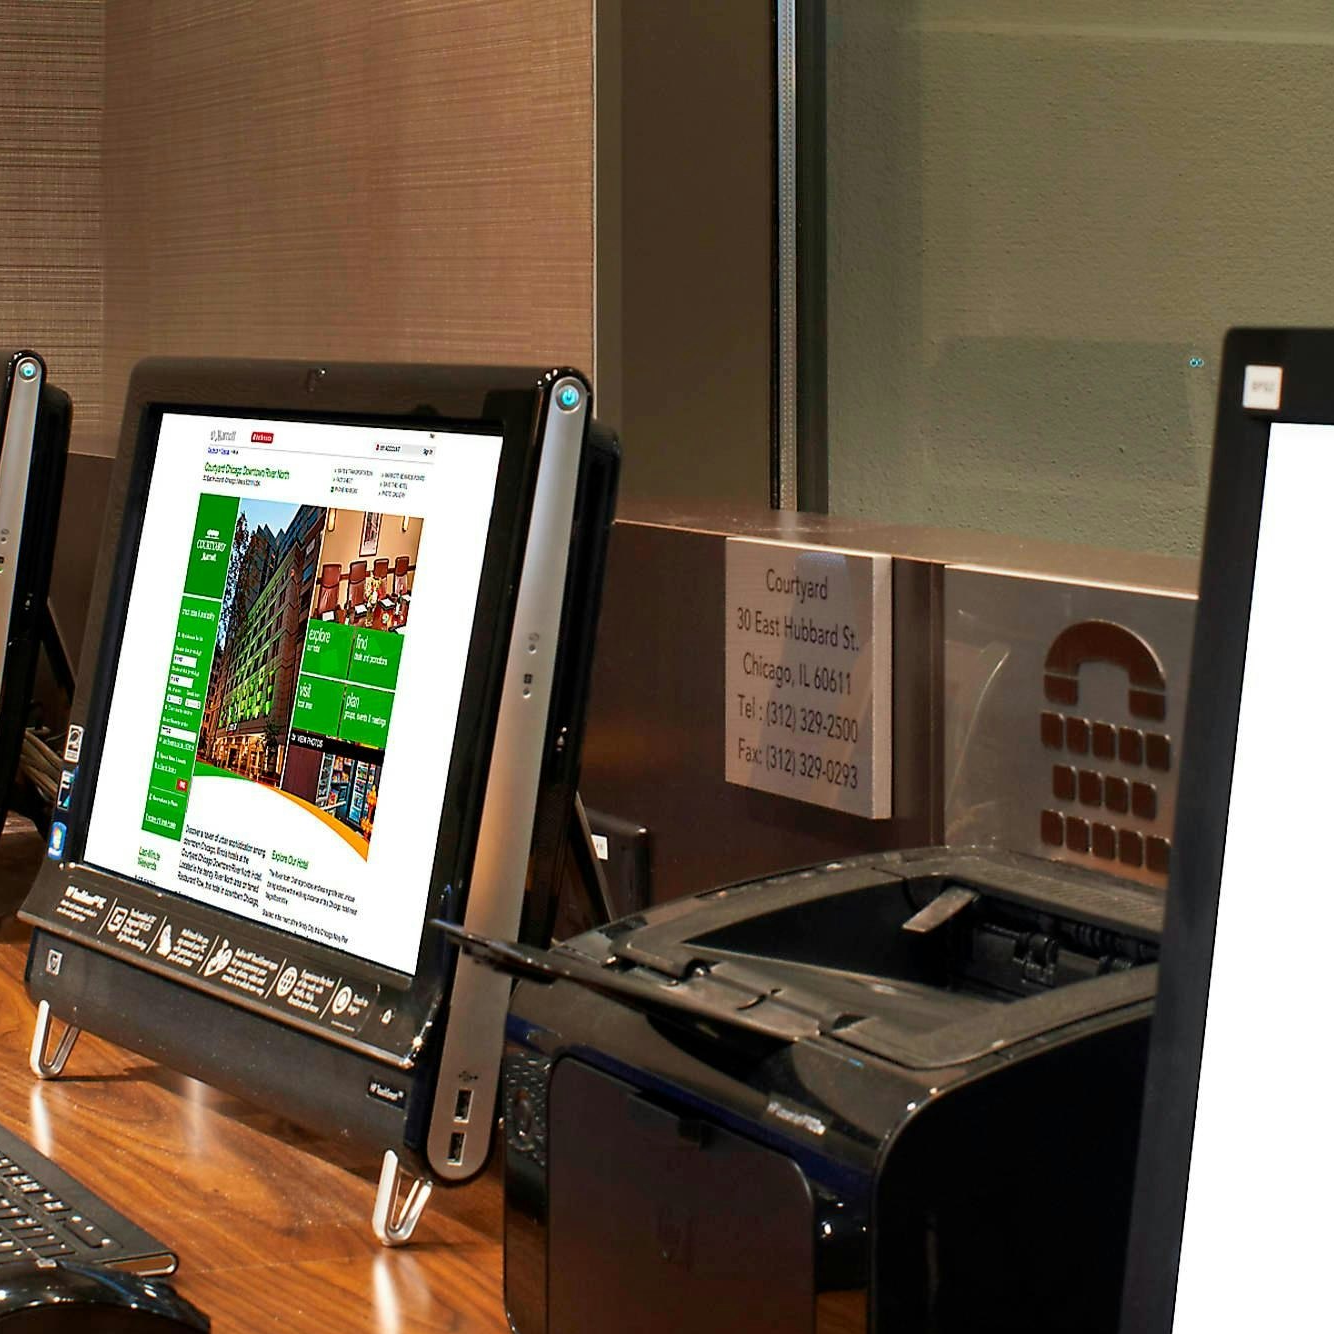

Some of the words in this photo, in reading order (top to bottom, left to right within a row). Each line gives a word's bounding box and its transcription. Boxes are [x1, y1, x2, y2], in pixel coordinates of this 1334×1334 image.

[766, 568, 828, 605] Courtyard
[308, 627, 331, 645] explore
[356, 633, 369, 651] find
[736, 606, 753, 633] 30
[755, 610, 780, 637] East
[784, 615, 838, 647] Hubbard
[842, 624, 859, 651] St.
[298, 682, 312, 698] visit
[743, 651, 795, 689] Chicago,
[799, 664, 811, 688] IL
[814, 667, 851, 695] 60611
[345, 692, 360, 709] plan
[766, 701, 796, 732] (312)
[800, 708, 858, 744] 329-2500
[766, 745, 796, 777] (312)
[799, 752, 858, 790] 329-0293
